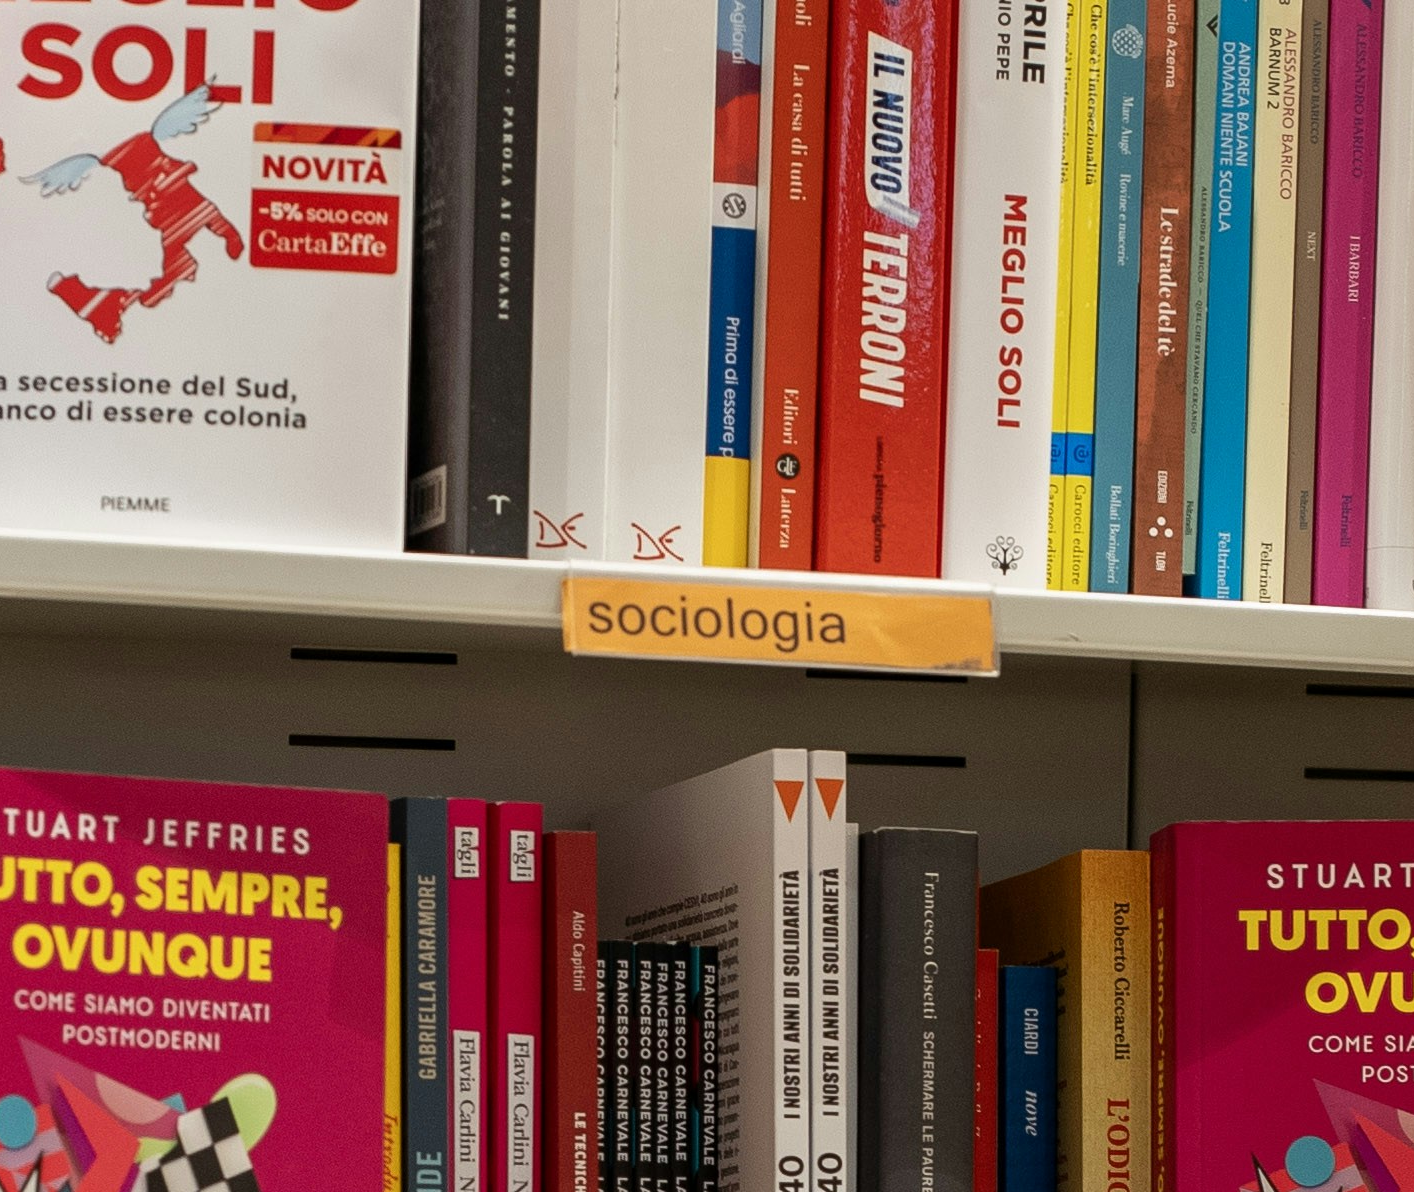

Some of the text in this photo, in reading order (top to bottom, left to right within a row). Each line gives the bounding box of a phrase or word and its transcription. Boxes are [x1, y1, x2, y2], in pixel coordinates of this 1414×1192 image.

[17, 22, 275, 105] SOLI
[1235, 41, 1252, 167] ANDREA BAJANI
[1218, 41, 1236, 233] DOMANI NIENTE SCUOLA
[261, 152, 388, 186] NOVITÀ
[258, 200, 389, 228] -5% SOLO CON
[858, 50, 909, 408] IL NUOVO TERRONI
[256, 229, 388, 259] CartaEffe
[996, 193, 1028, 429] MEGLIO SOLI
[17, 372, 172, 396] secessione
[183, 375, 226, 398] del
[235, 376, 299, 402] Sud,
[66, 400, 94, 424] di
[103, 404, 195, 426] essere
[203, 404, 308, 430] colonia
[100, 496, 170, 513] PIEMME
[588, 595, 846, 653] sociologia
[1308, 1035, 1374, 1053] COME
